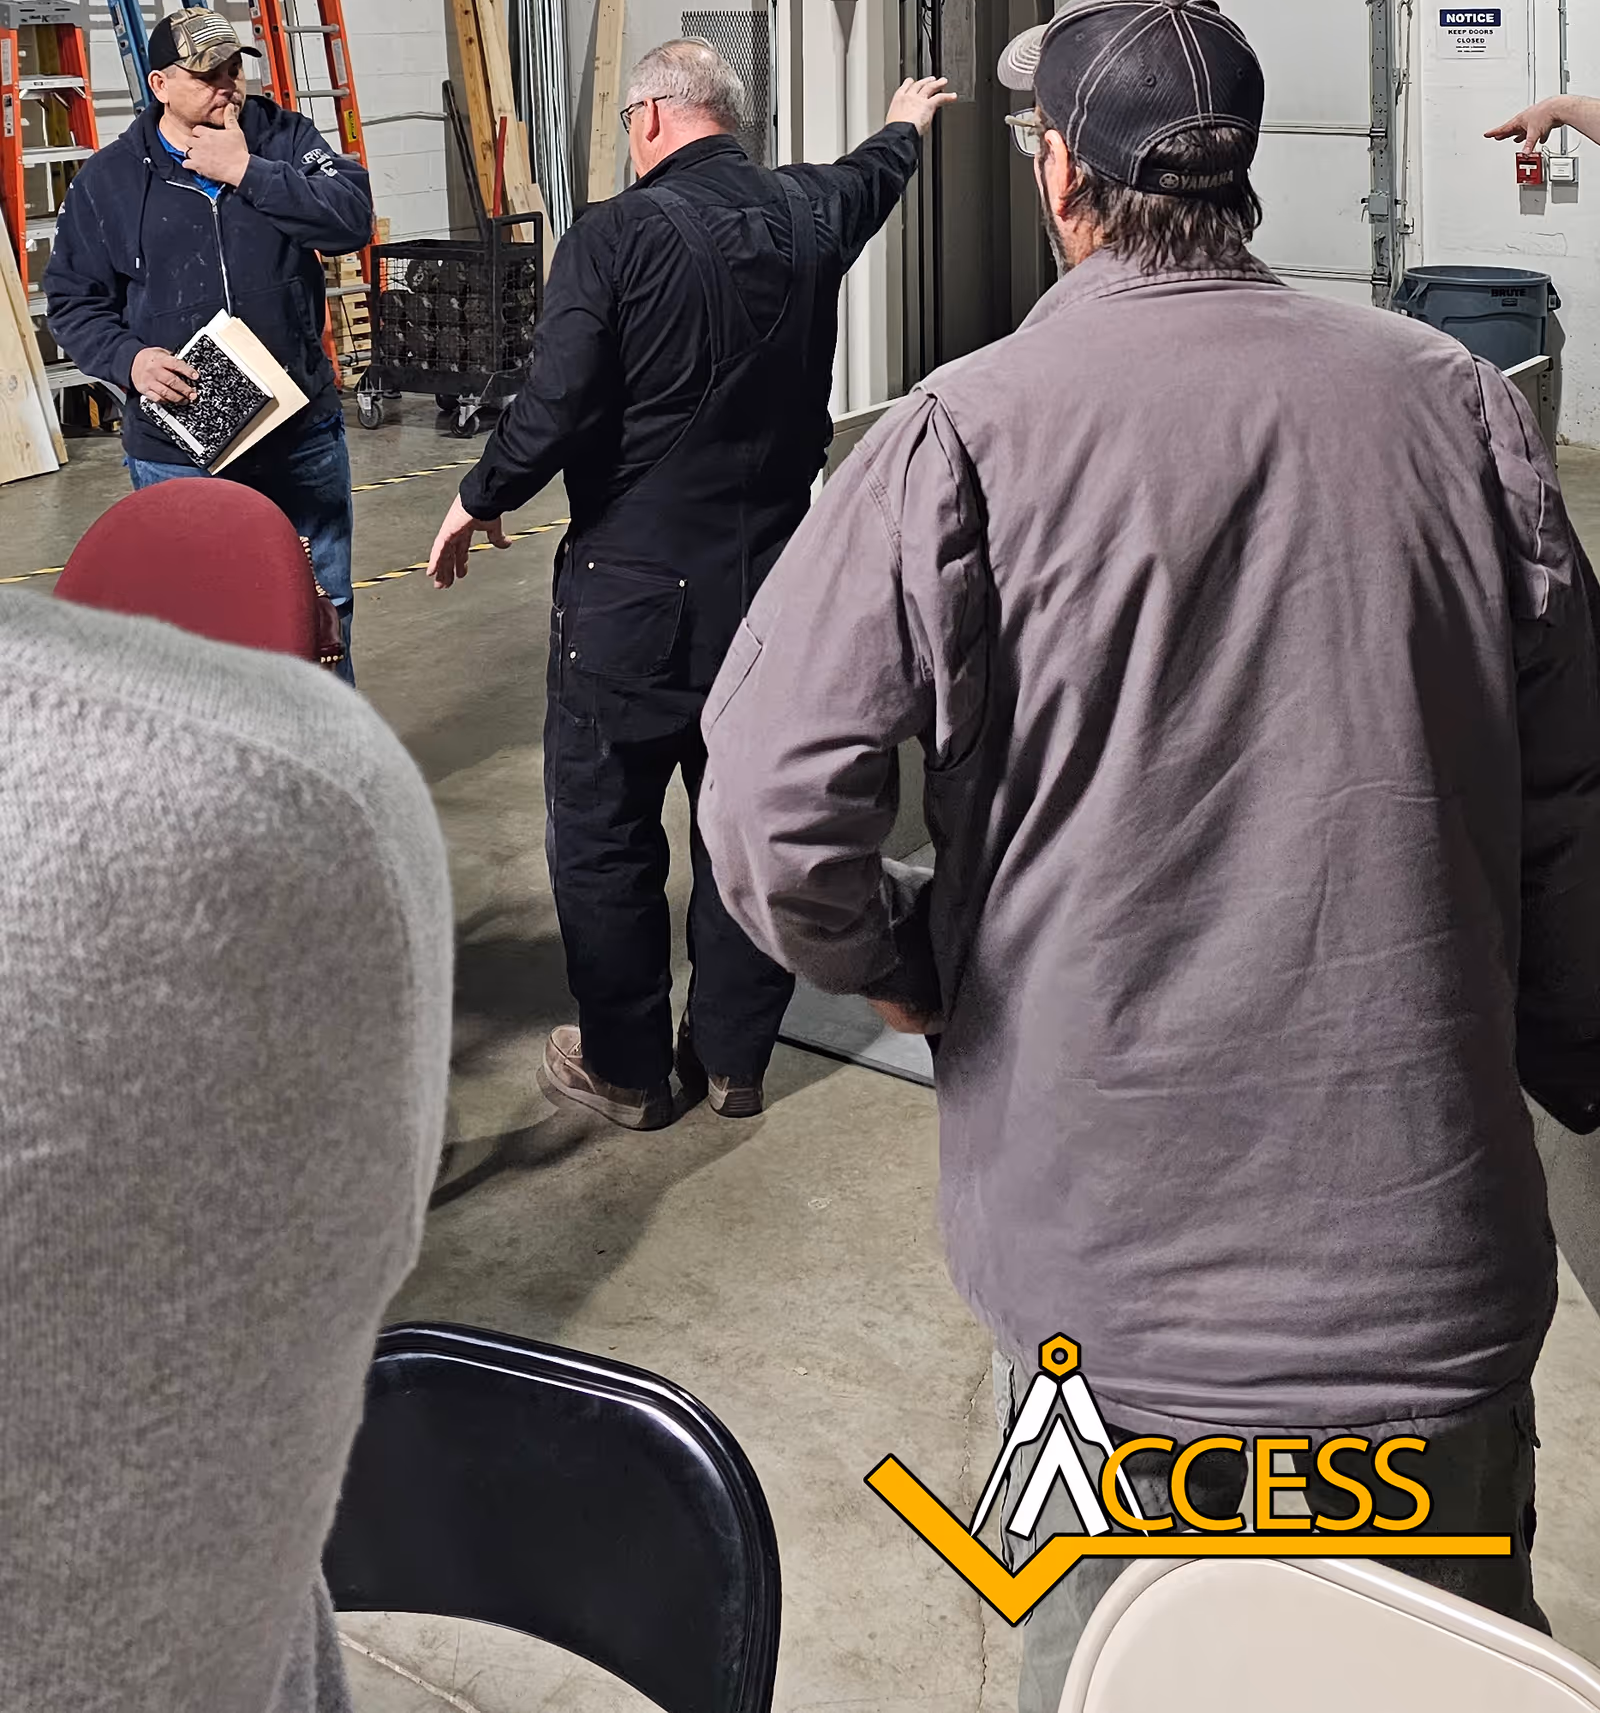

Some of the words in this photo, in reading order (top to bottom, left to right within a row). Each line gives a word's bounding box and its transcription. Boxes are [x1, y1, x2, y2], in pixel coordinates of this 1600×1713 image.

[1446, 13, 1495, 23] NOTICE
[1181, 170, 1234, 189] YAMAHA
[1491, 288, 1527, 297] BRUTE
